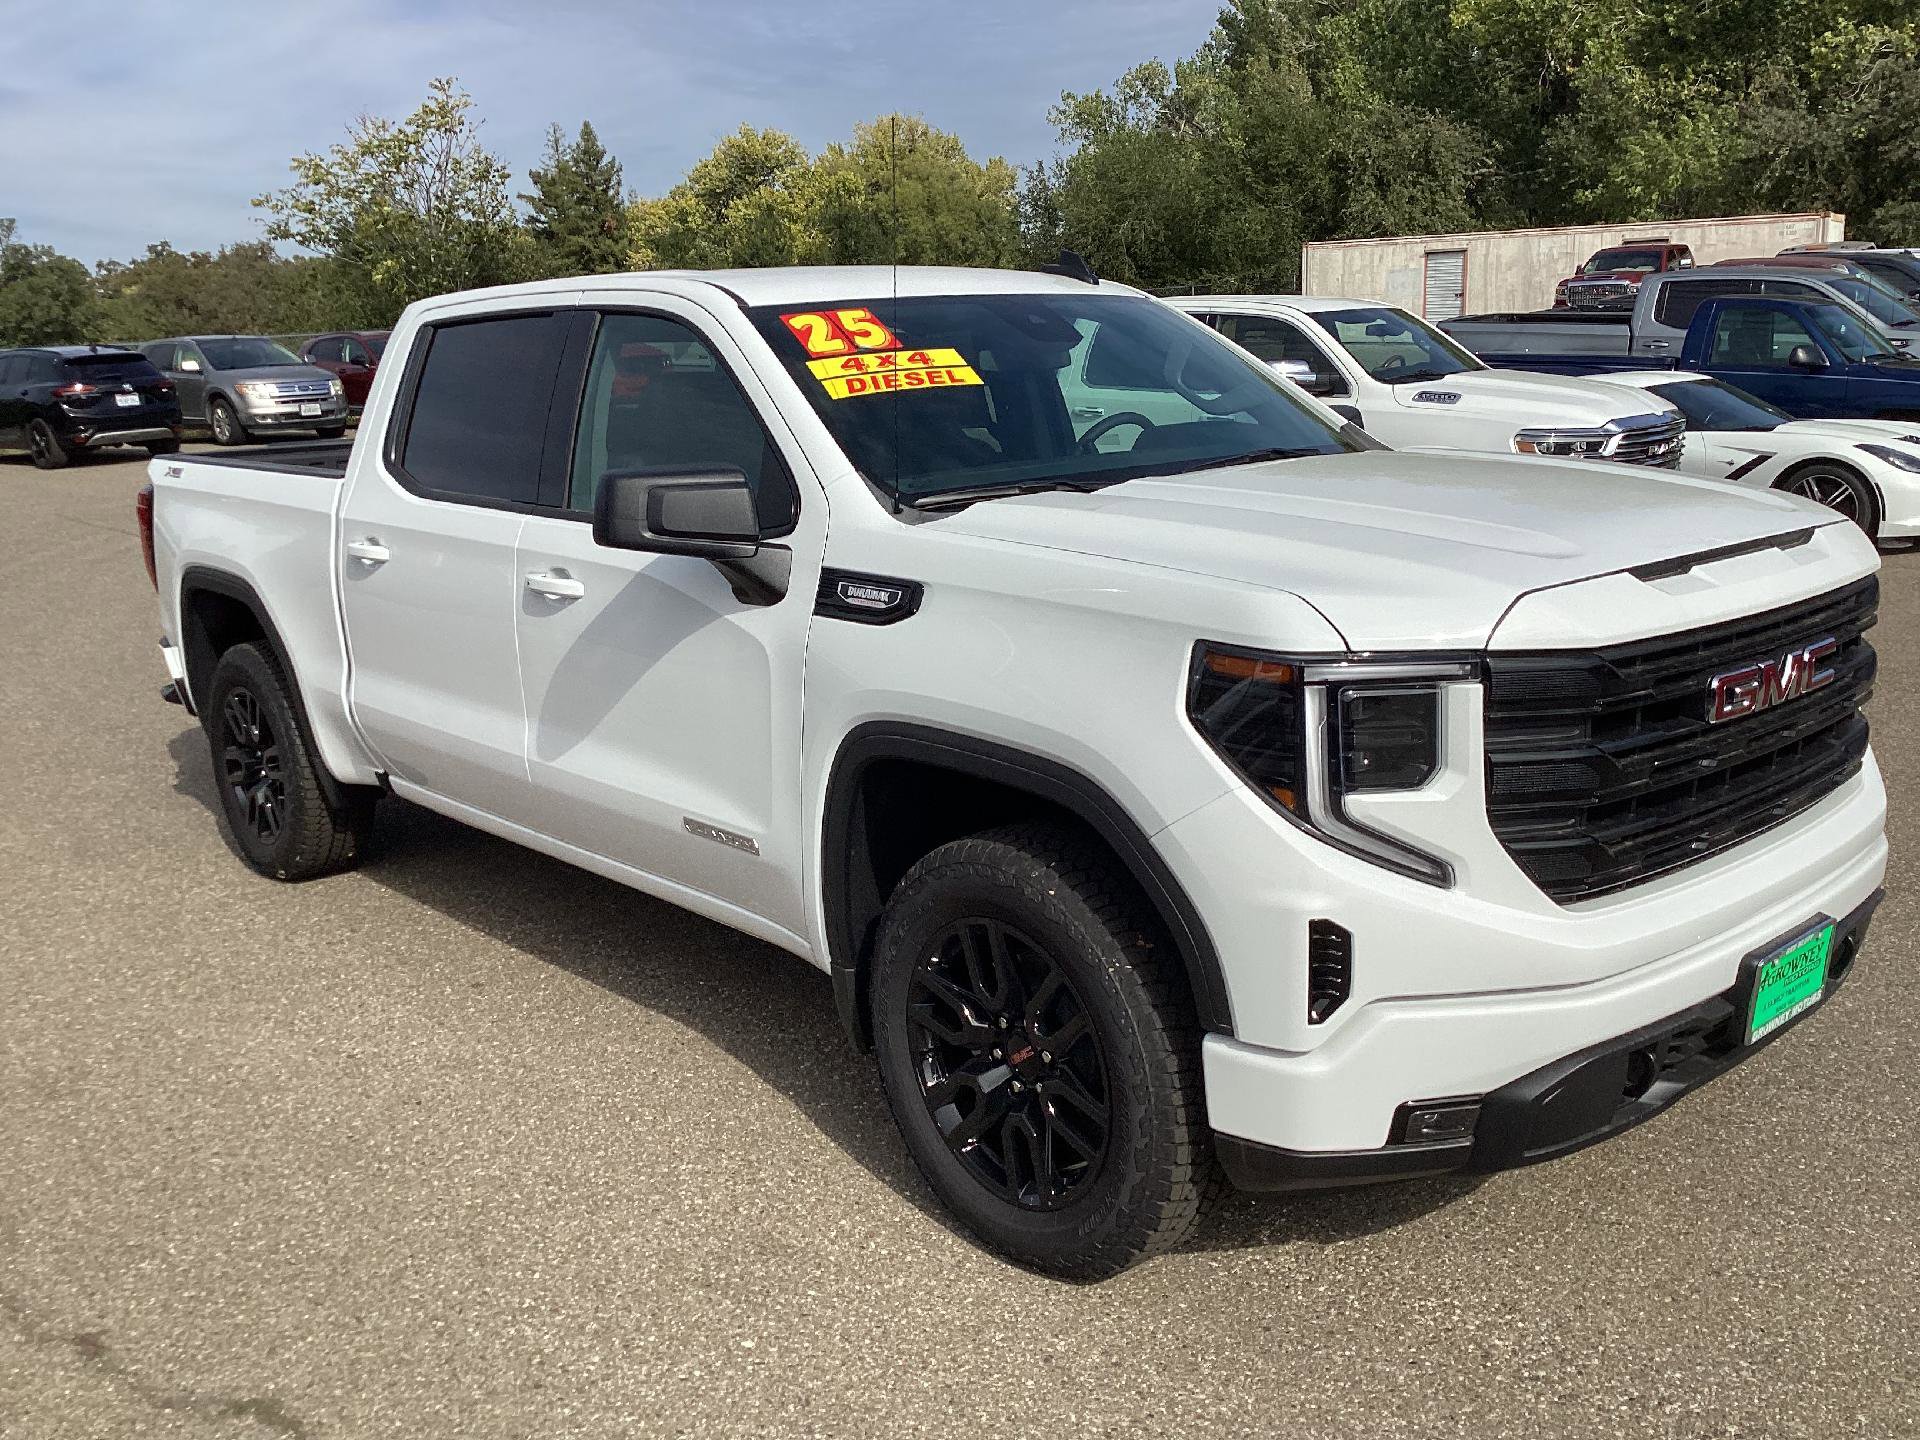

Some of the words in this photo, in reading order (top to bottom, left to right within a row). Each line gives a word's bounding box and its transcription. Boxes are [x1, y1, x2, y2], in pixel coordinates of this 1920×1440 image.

[789, 309, 891, 354] 25
[845, 370, 965, 394] DIESEL
[847, 585, 890, 602] DURAMAX
[1705, 636, 1837, 724] GMC
[1768, 942, 1825, 987] GROWNEY
